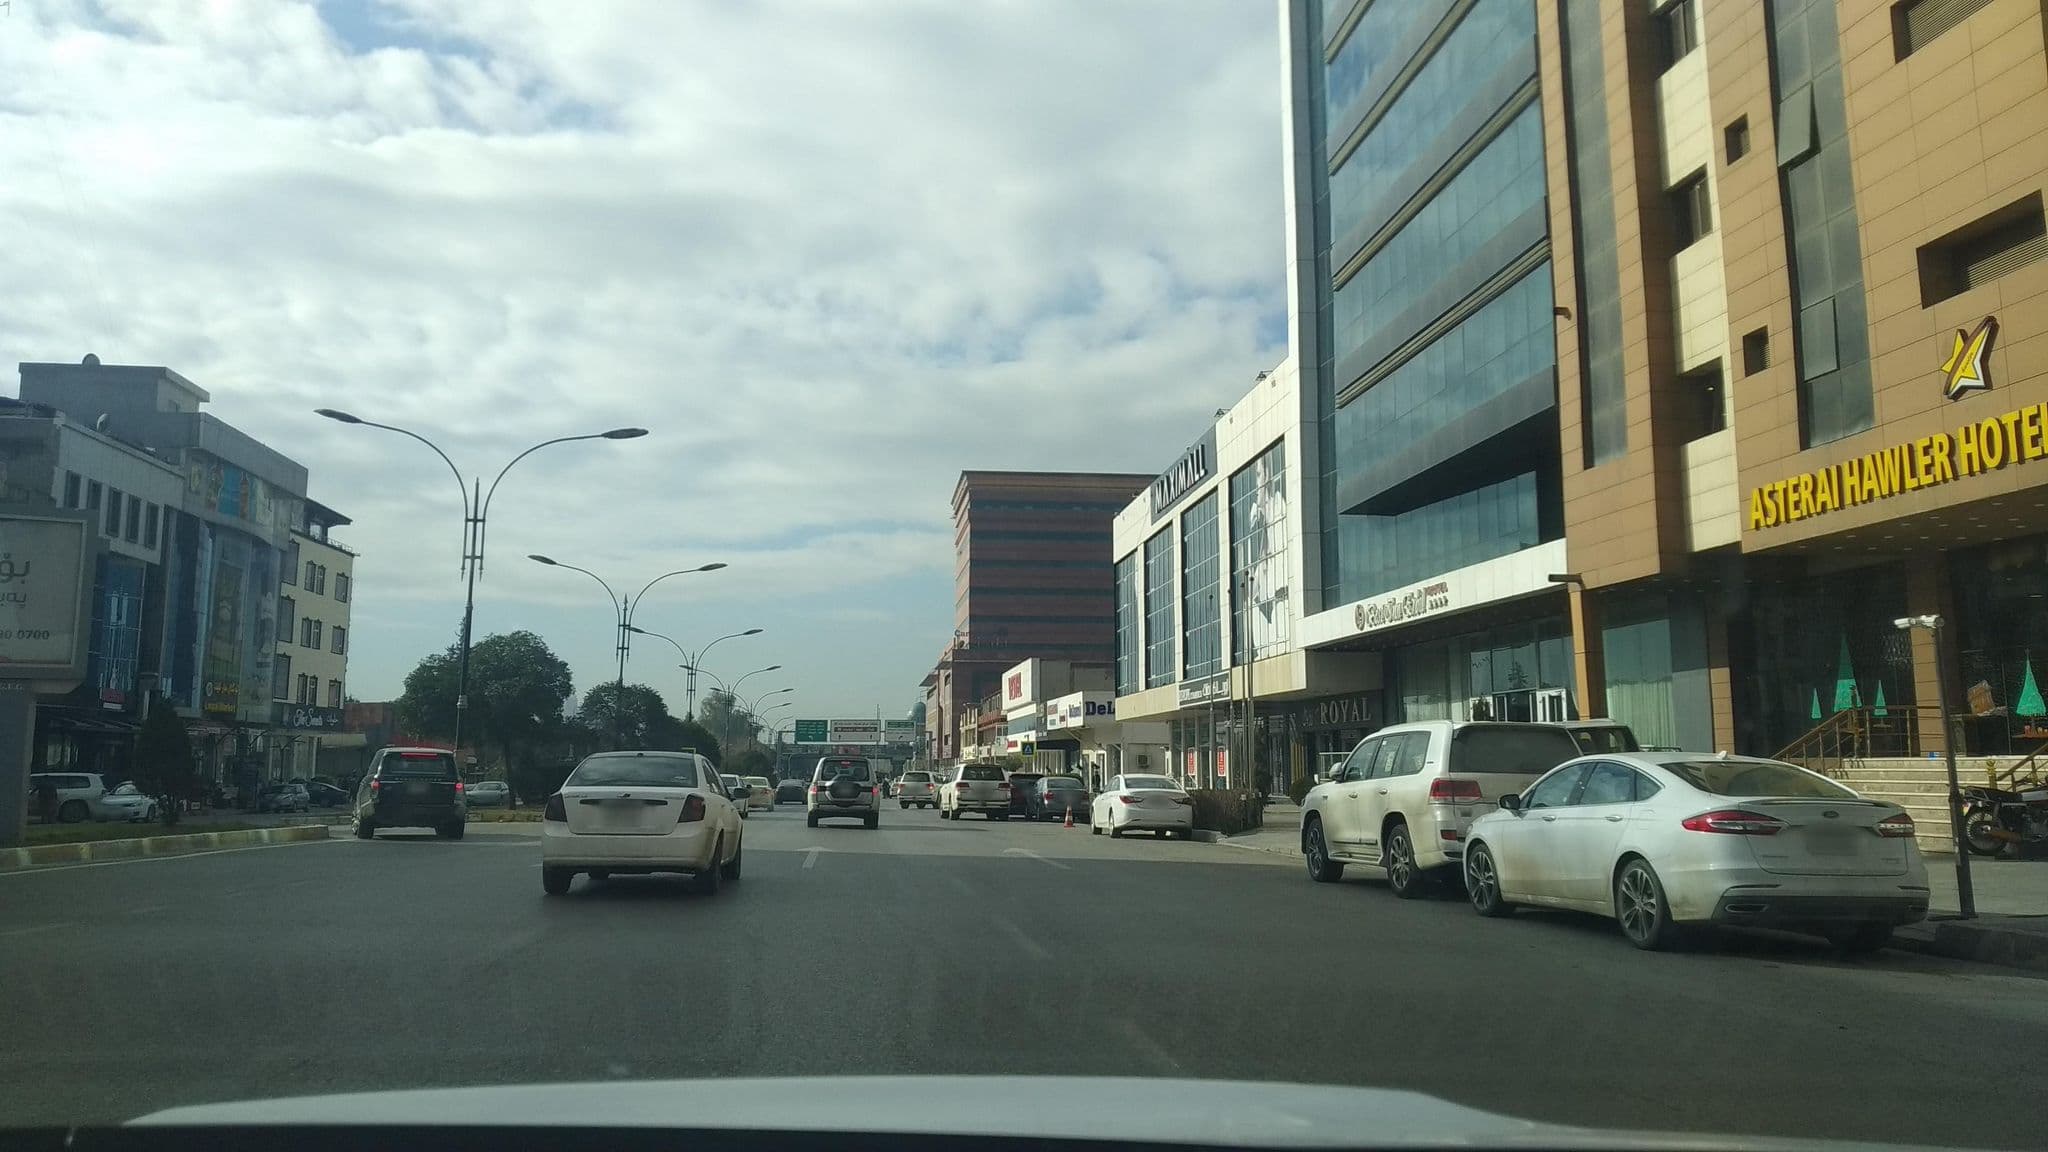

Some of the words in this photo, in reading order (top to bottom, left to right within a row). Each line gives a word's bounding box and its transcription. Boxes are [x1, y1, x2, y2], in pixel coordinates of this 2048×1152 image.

[1155, 444, 1206, 514] MAXIMALL
[1750, 465, 1842, 530] ASTERAI
[1843, 433, 1954, 506] HAWLER
[1320, 697, 1372, 725] ROYAL
